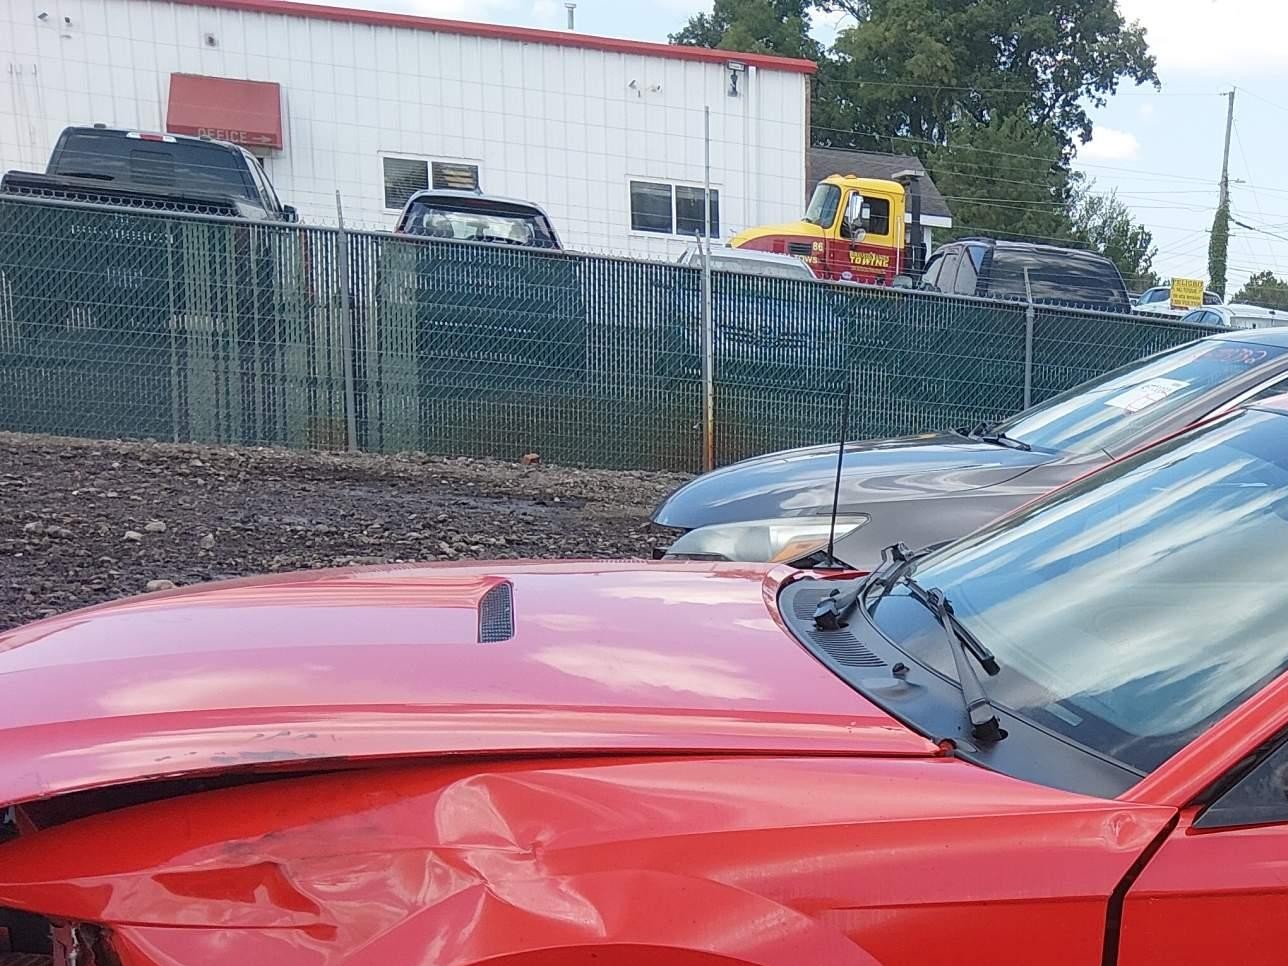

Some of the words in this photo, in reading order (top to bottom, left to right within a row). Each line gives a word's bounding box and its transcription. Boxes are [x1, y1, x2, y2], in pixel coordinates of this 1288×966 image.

[197, 127, 248, 143] OFFICE
[812, 241, 824, 252] 86
[849, 256, 889, 268] TOWING
